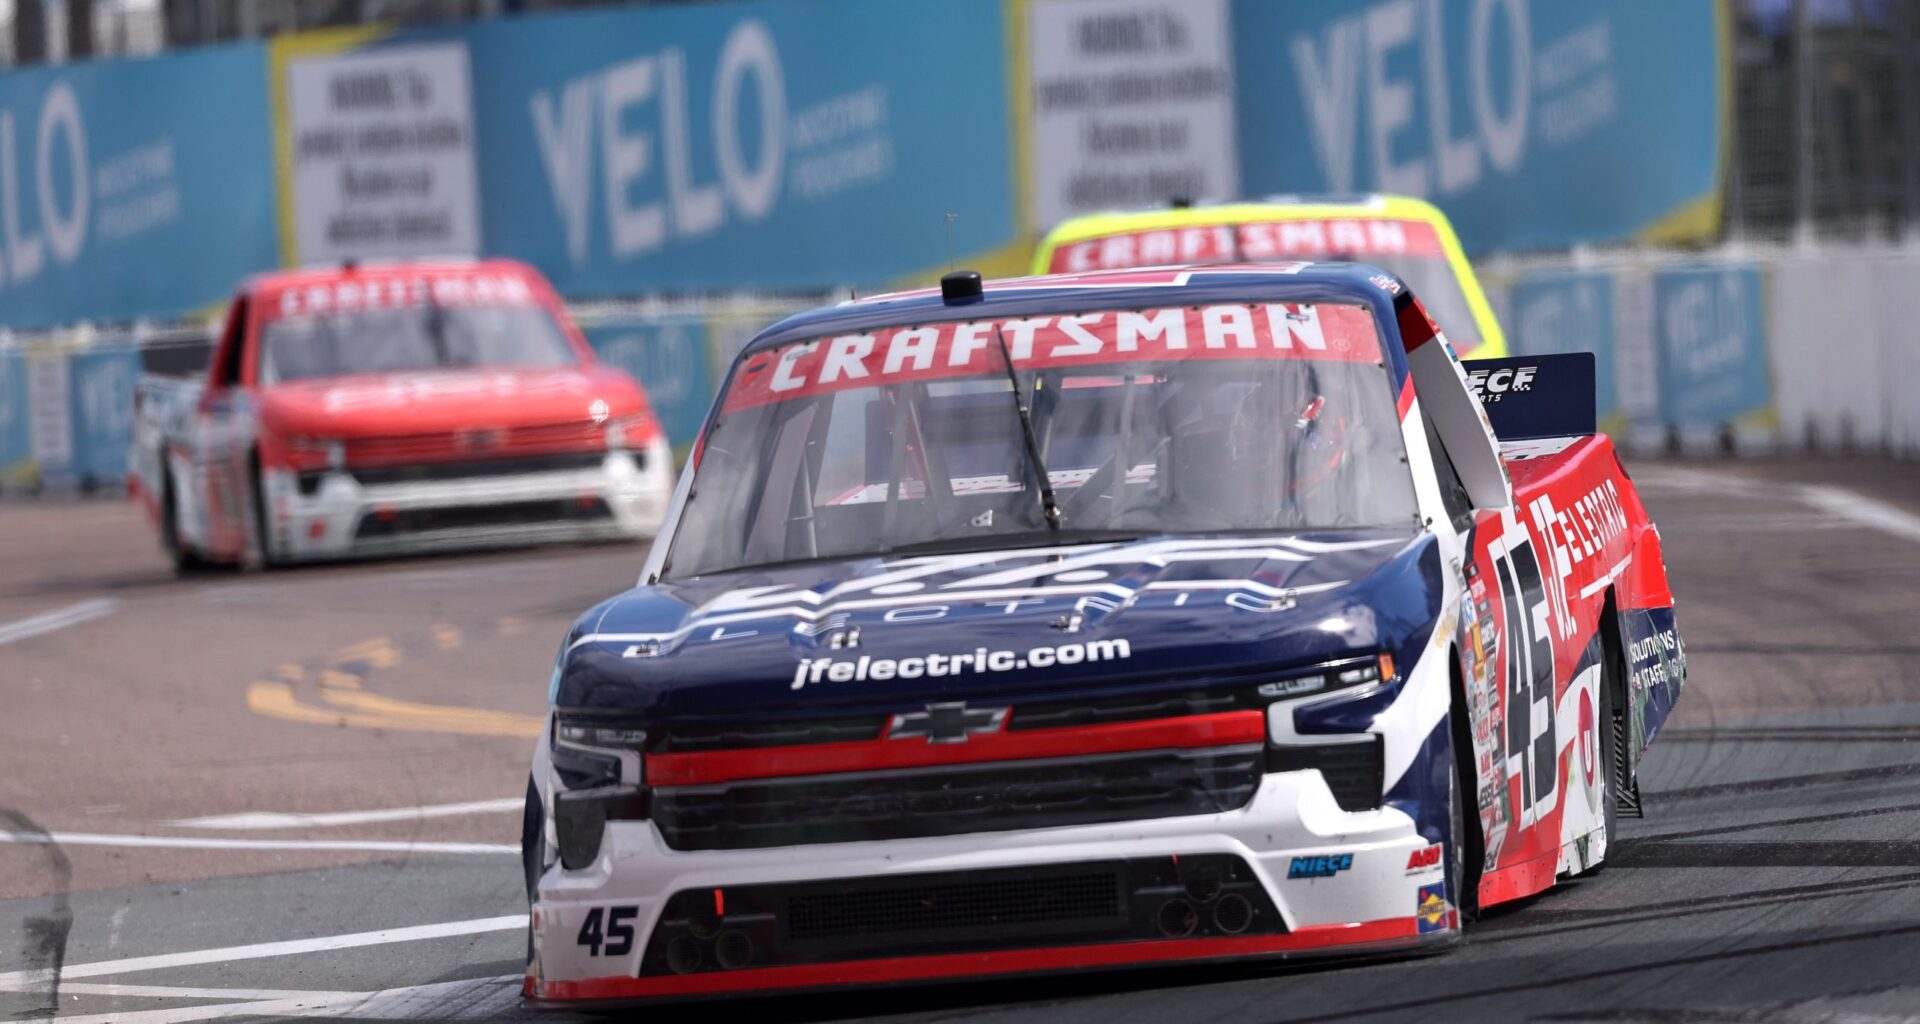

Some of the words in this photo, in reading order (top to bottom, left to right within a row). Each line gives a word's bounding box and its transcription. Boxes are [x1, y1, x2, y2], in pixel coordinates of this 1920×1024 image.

[0, 80, 90, 284] LO
[530, 19, 787, 268] VELO
[1068, 219, 1407, 270] CRAFTSMAN
[768, 302, 1327, 393] CRAFTSMAN
[1557, 479, 1627, 563] ELECTRIC
[792, 638, 1130, 690] jfelectric.com
[1490, 533, 1558, 828] 45
[1290, 854, 1353, 873] NIECE
[577, 905, 639, 957] 45
